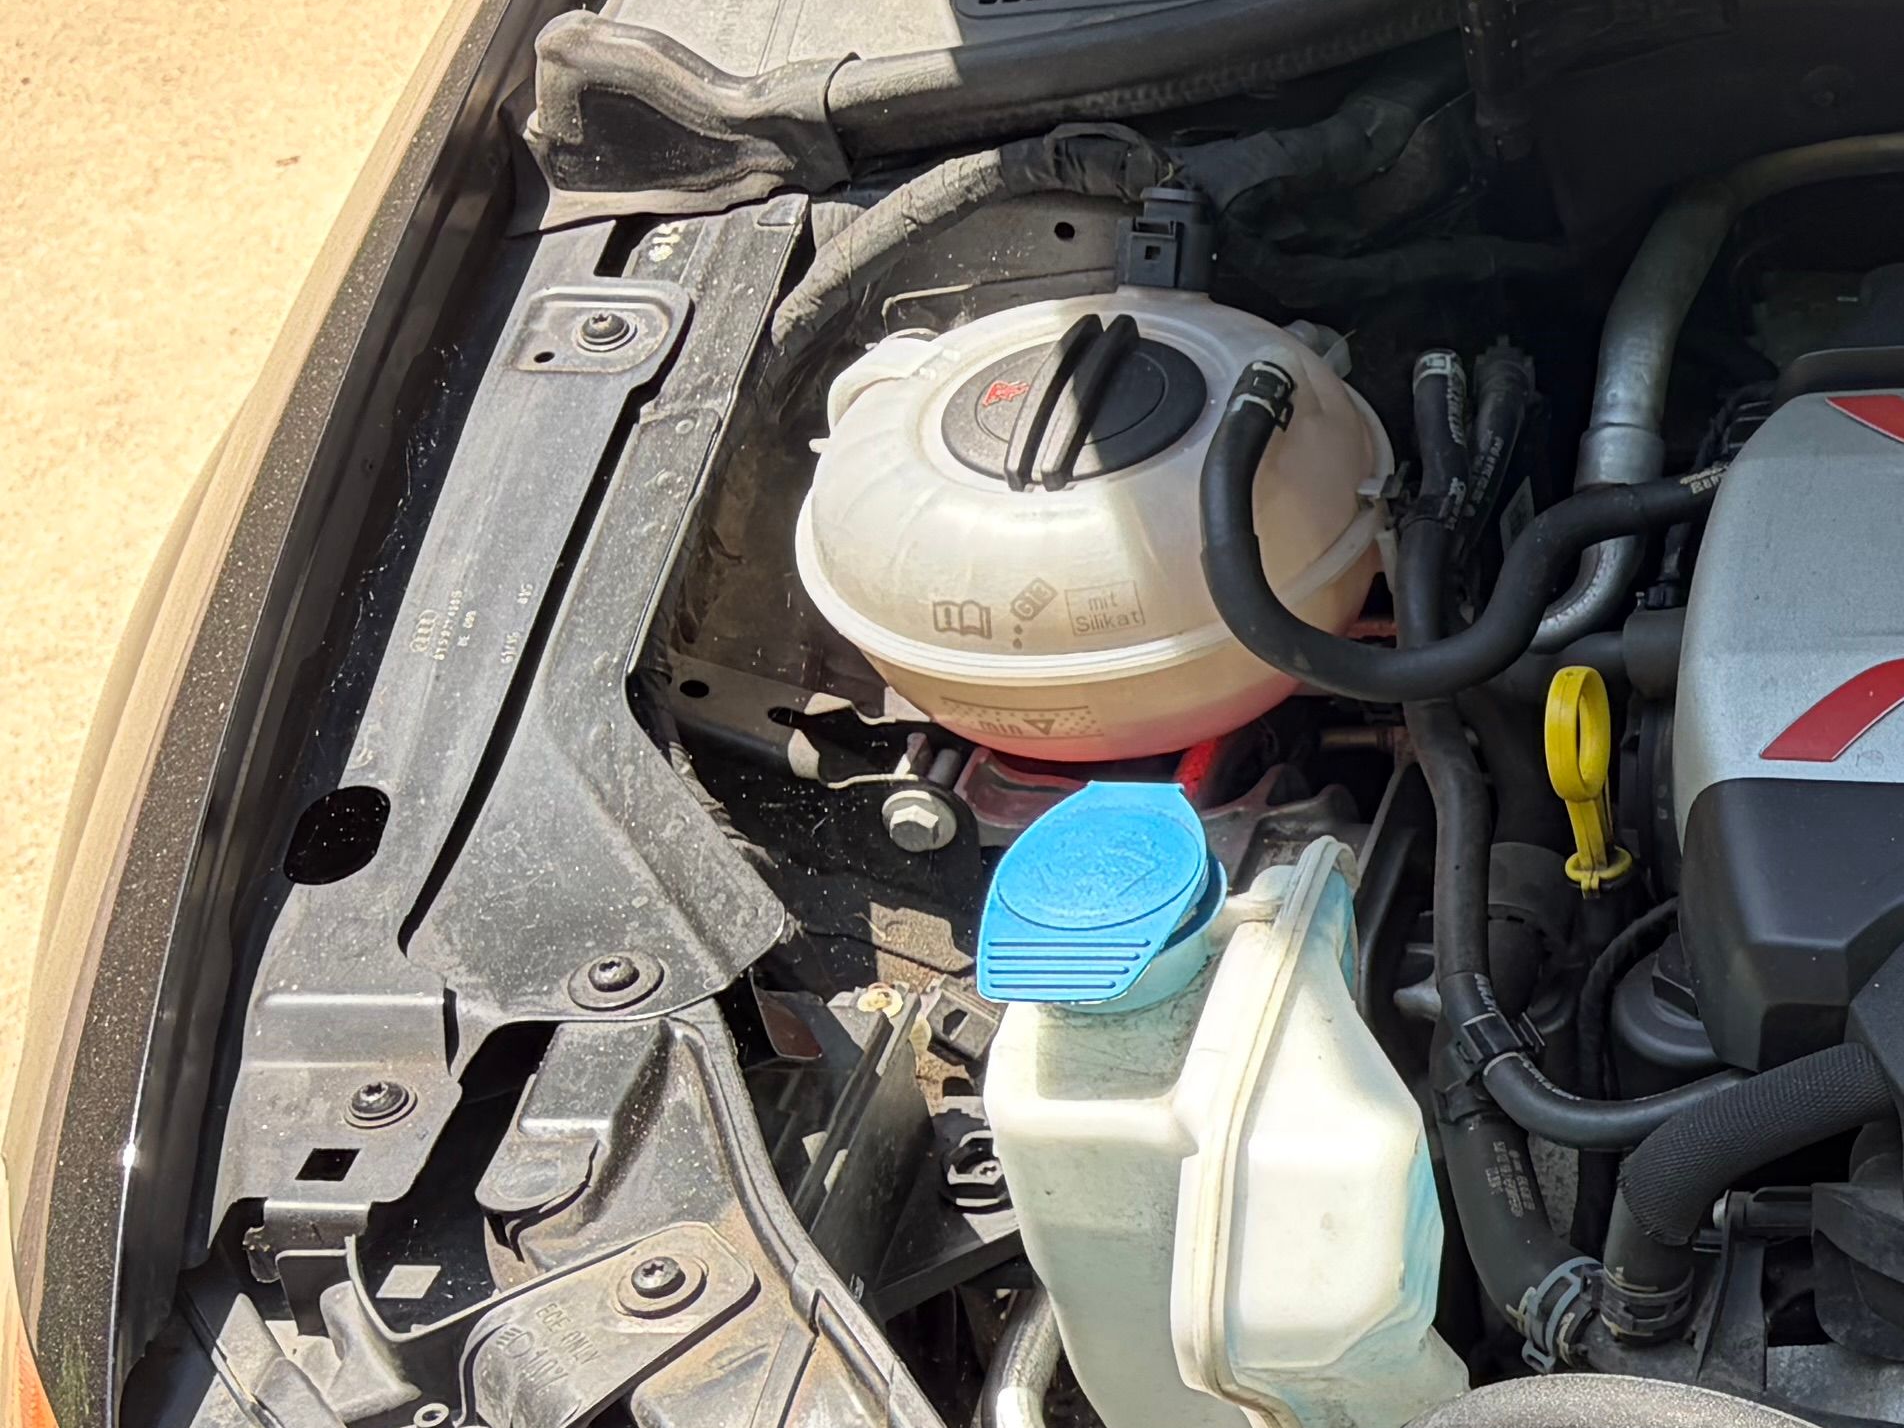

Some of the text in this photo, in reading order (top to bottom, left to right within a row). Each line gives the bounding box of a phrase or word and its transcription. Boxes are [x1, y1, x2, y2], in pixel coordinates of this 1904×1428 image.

[1088, 590, 1119, 612] mit
[1075, 610, 1141, 633] Silikat
[978, 715, 1024, 737] min
